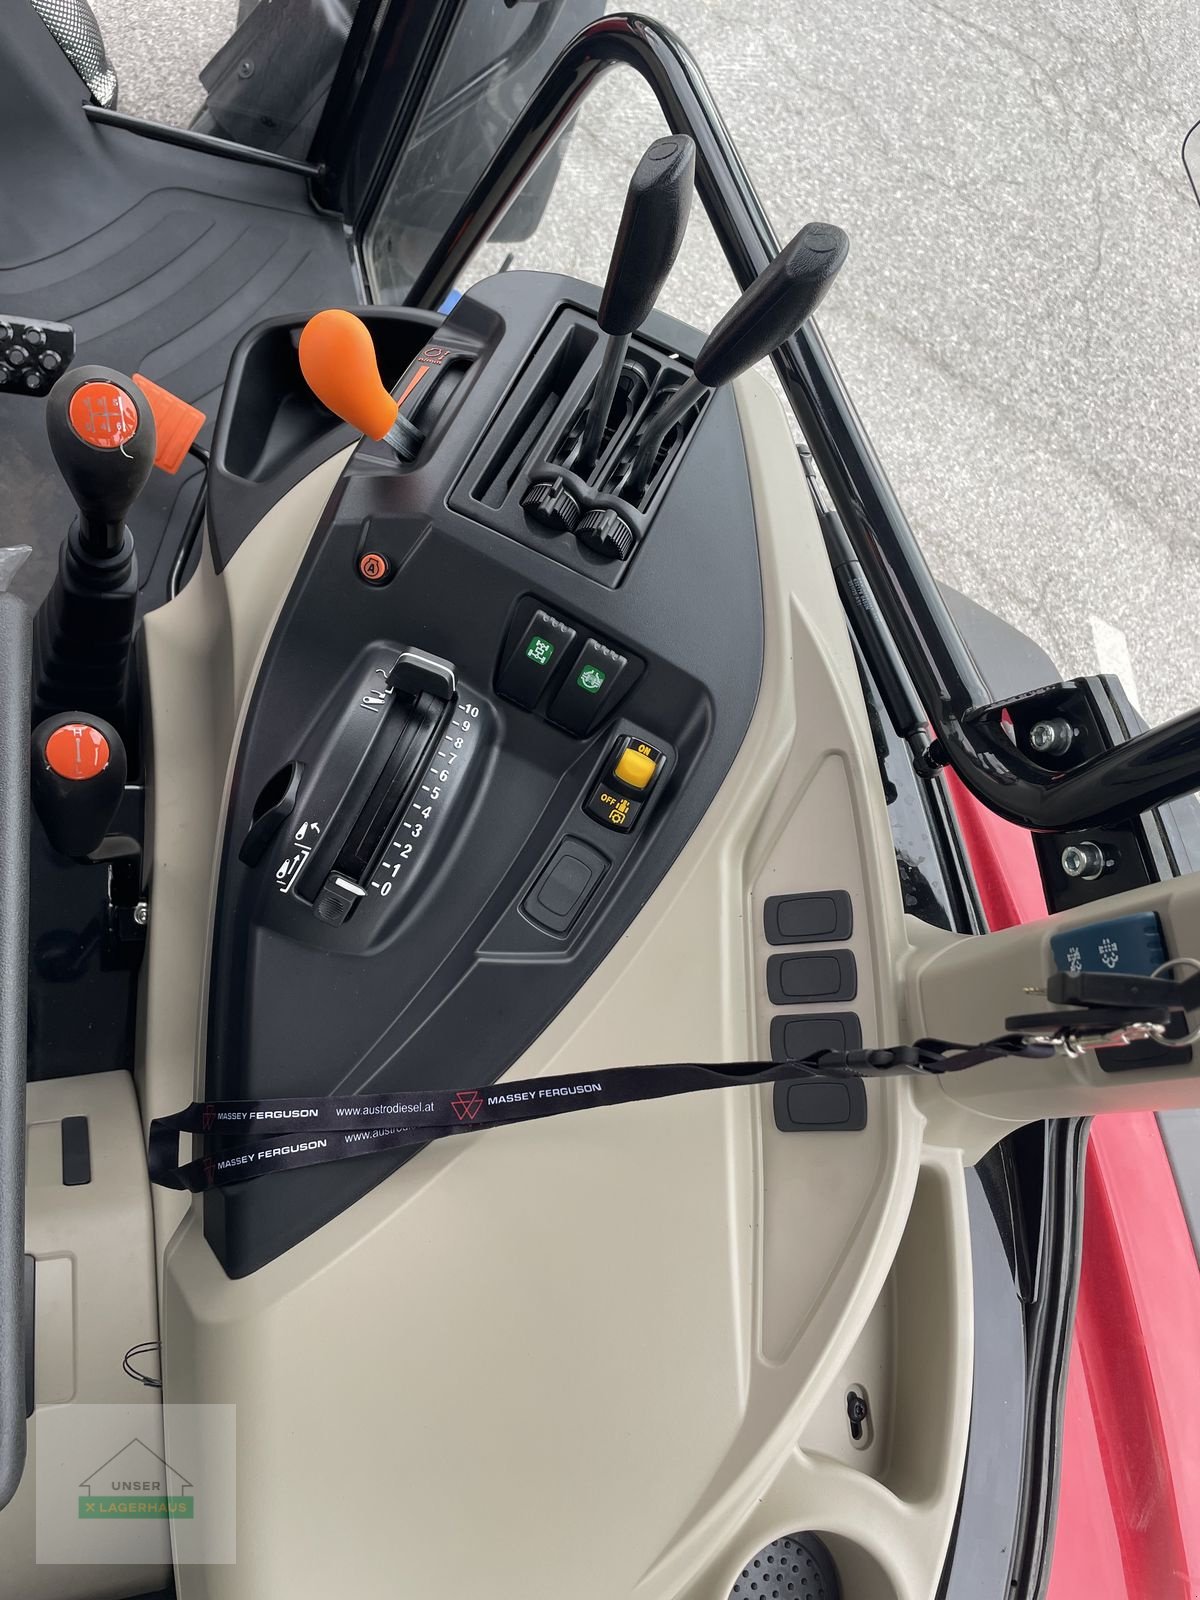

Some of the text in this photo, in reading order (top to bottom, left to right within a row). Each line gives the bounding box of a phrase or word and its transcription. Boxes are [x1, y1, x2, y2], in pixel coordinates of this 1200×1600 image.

[465, 703, 479, 718] 10
[461, 720, 471, 732] 9
[453, 737, 464, 749] 8
[638, 744, 652, 756] ON
[448, 752, 458, 765] 7
[439, 769, 450, 782] 6
[430, 786, 441, 799] 5
[600, 793, 617, 806] OFF
[421, 806, 432, 819] 4
[411, 823, 423, 837] 3
[400, 844, 413, 859] 2
[391, 863, 401, 878] 1
[380, 881, 392, 897] 0
[487, 1083, 602, 1106] MASSEY FERGUSON
[217, 1109, 319, 1120] MASSEY FERGUSON
[335, 1101, 435, 1116] www.austrodiesel.at
[217, 1139, 327, 1170] MASSEY FERGUSON
